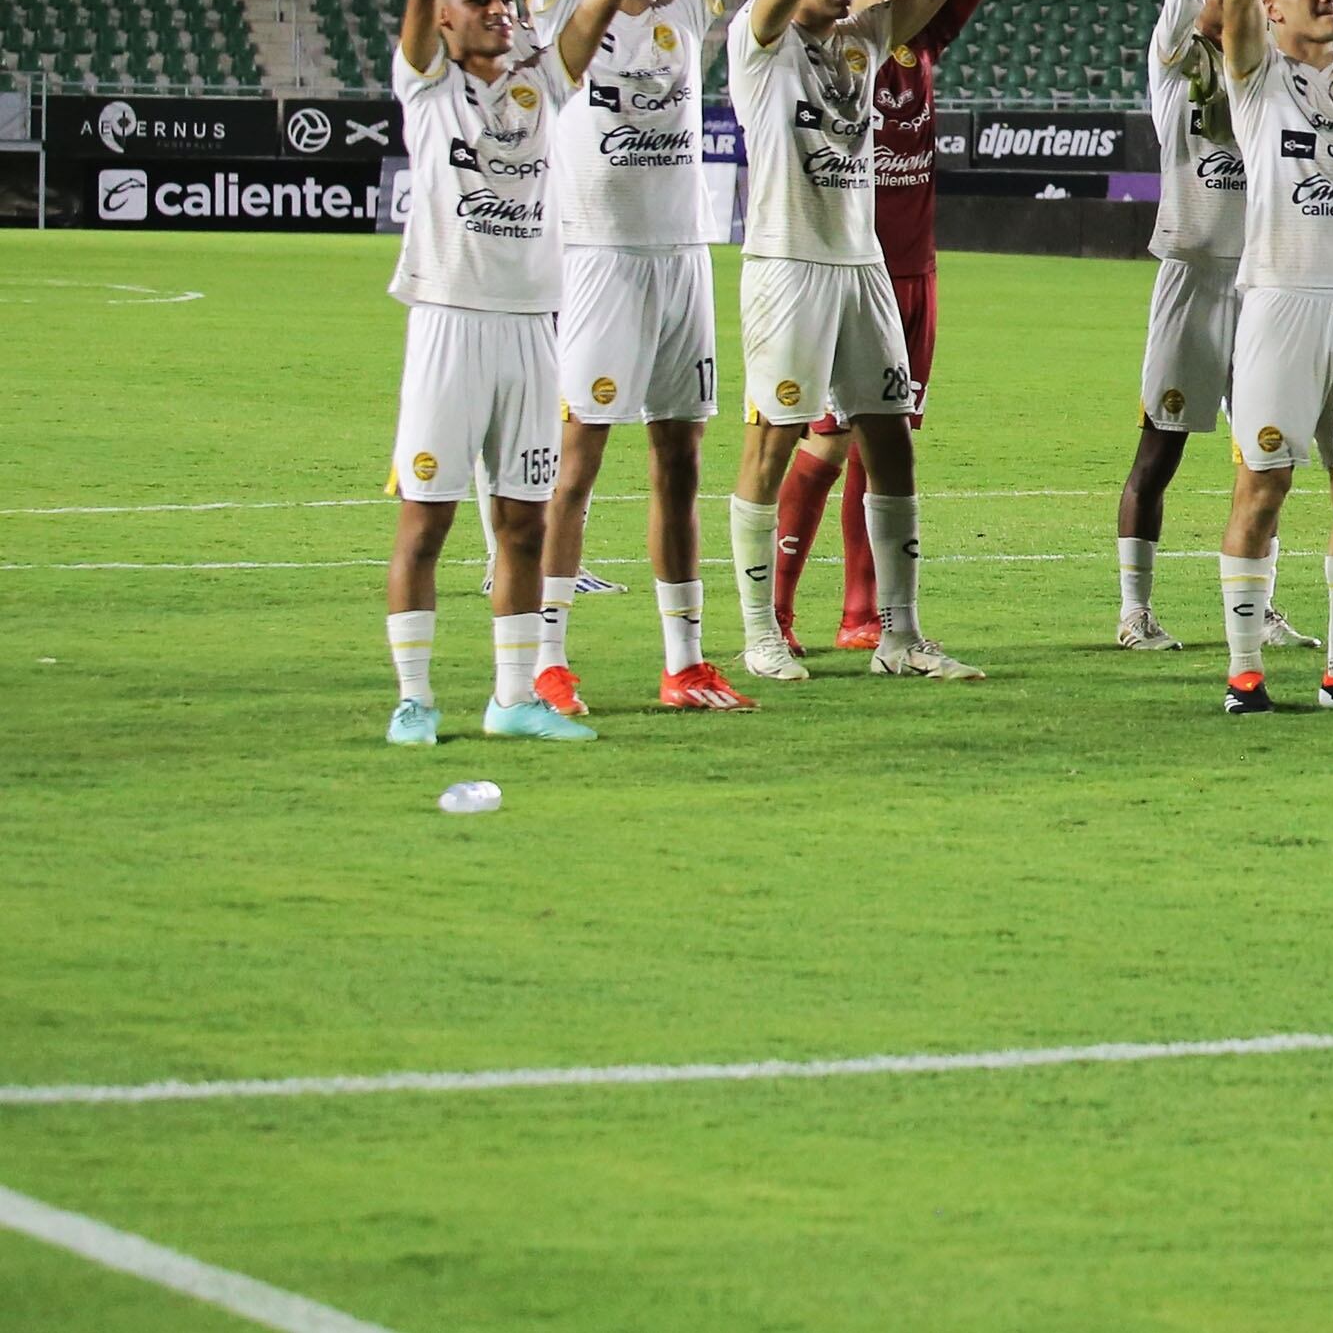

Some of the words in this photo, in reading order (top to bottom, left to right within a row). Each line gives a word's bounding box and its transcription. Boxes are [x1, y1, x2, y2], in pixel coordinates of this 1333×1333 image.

[978, 122, 1117, 159] dportenis
[696, 357, 714, 402] 17
[882, 366, 909, 401] 28
[520, 447, 552, 485] 155
